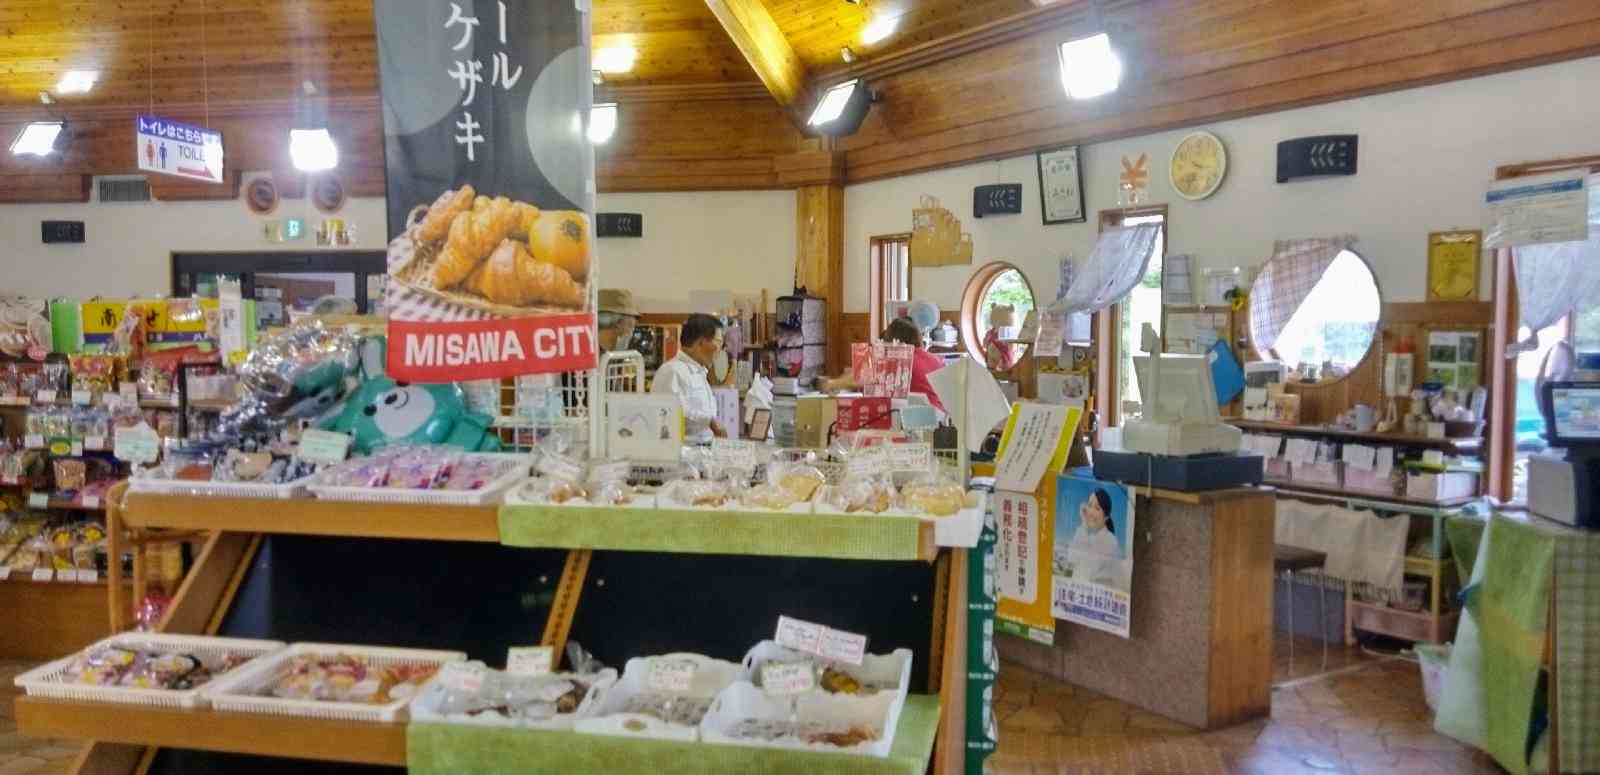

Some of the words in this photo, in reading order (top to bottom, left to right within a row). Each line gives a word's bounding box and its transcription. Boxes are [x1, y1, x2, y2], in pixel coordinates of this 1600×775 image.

[444, 2, 485, 161] ケザキ
[404, 330, 525, 367] MISAWA
